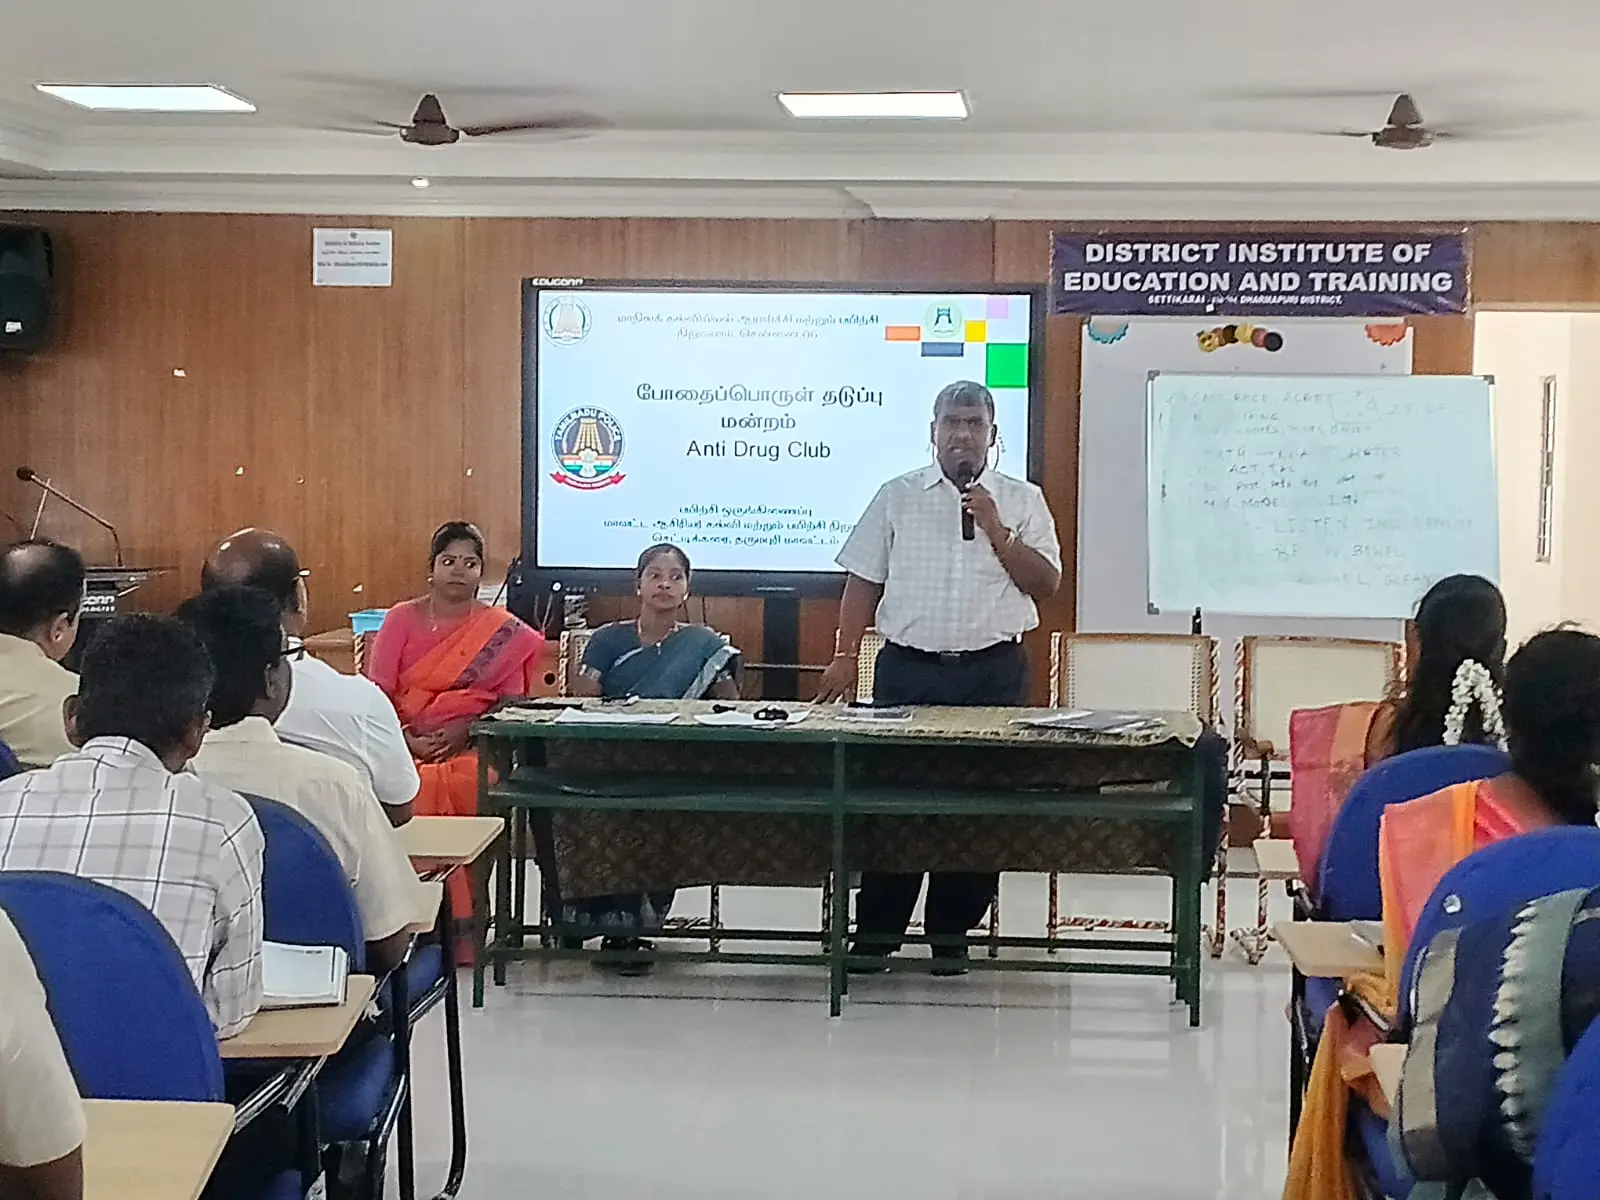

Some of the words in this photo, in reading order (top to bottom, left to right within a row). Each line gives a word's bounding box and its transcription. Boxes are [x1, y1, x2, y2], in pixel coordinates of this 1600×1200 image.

[1085, 243, 1220, 263] DISTRICT
[1228, 243, 1384, 263] INSTITUTE
[1391, 243, 1432, 263] OF
[1064, 272, 1231, 292] EDUCATION
[1238, 272, 1300, 292] AND
[1308, 272, 1453, 292] TRAINING
[636, 383, 815, 407] போதைப்பொருள்
[821, 385, 883, 408] தடுப்பு
[721, 413, 796, 433] மன்றம்
[686, 440, 726, 457] Anti
[734, 440, 780, 461] Drug
[788, 441, 831, 458] Club
